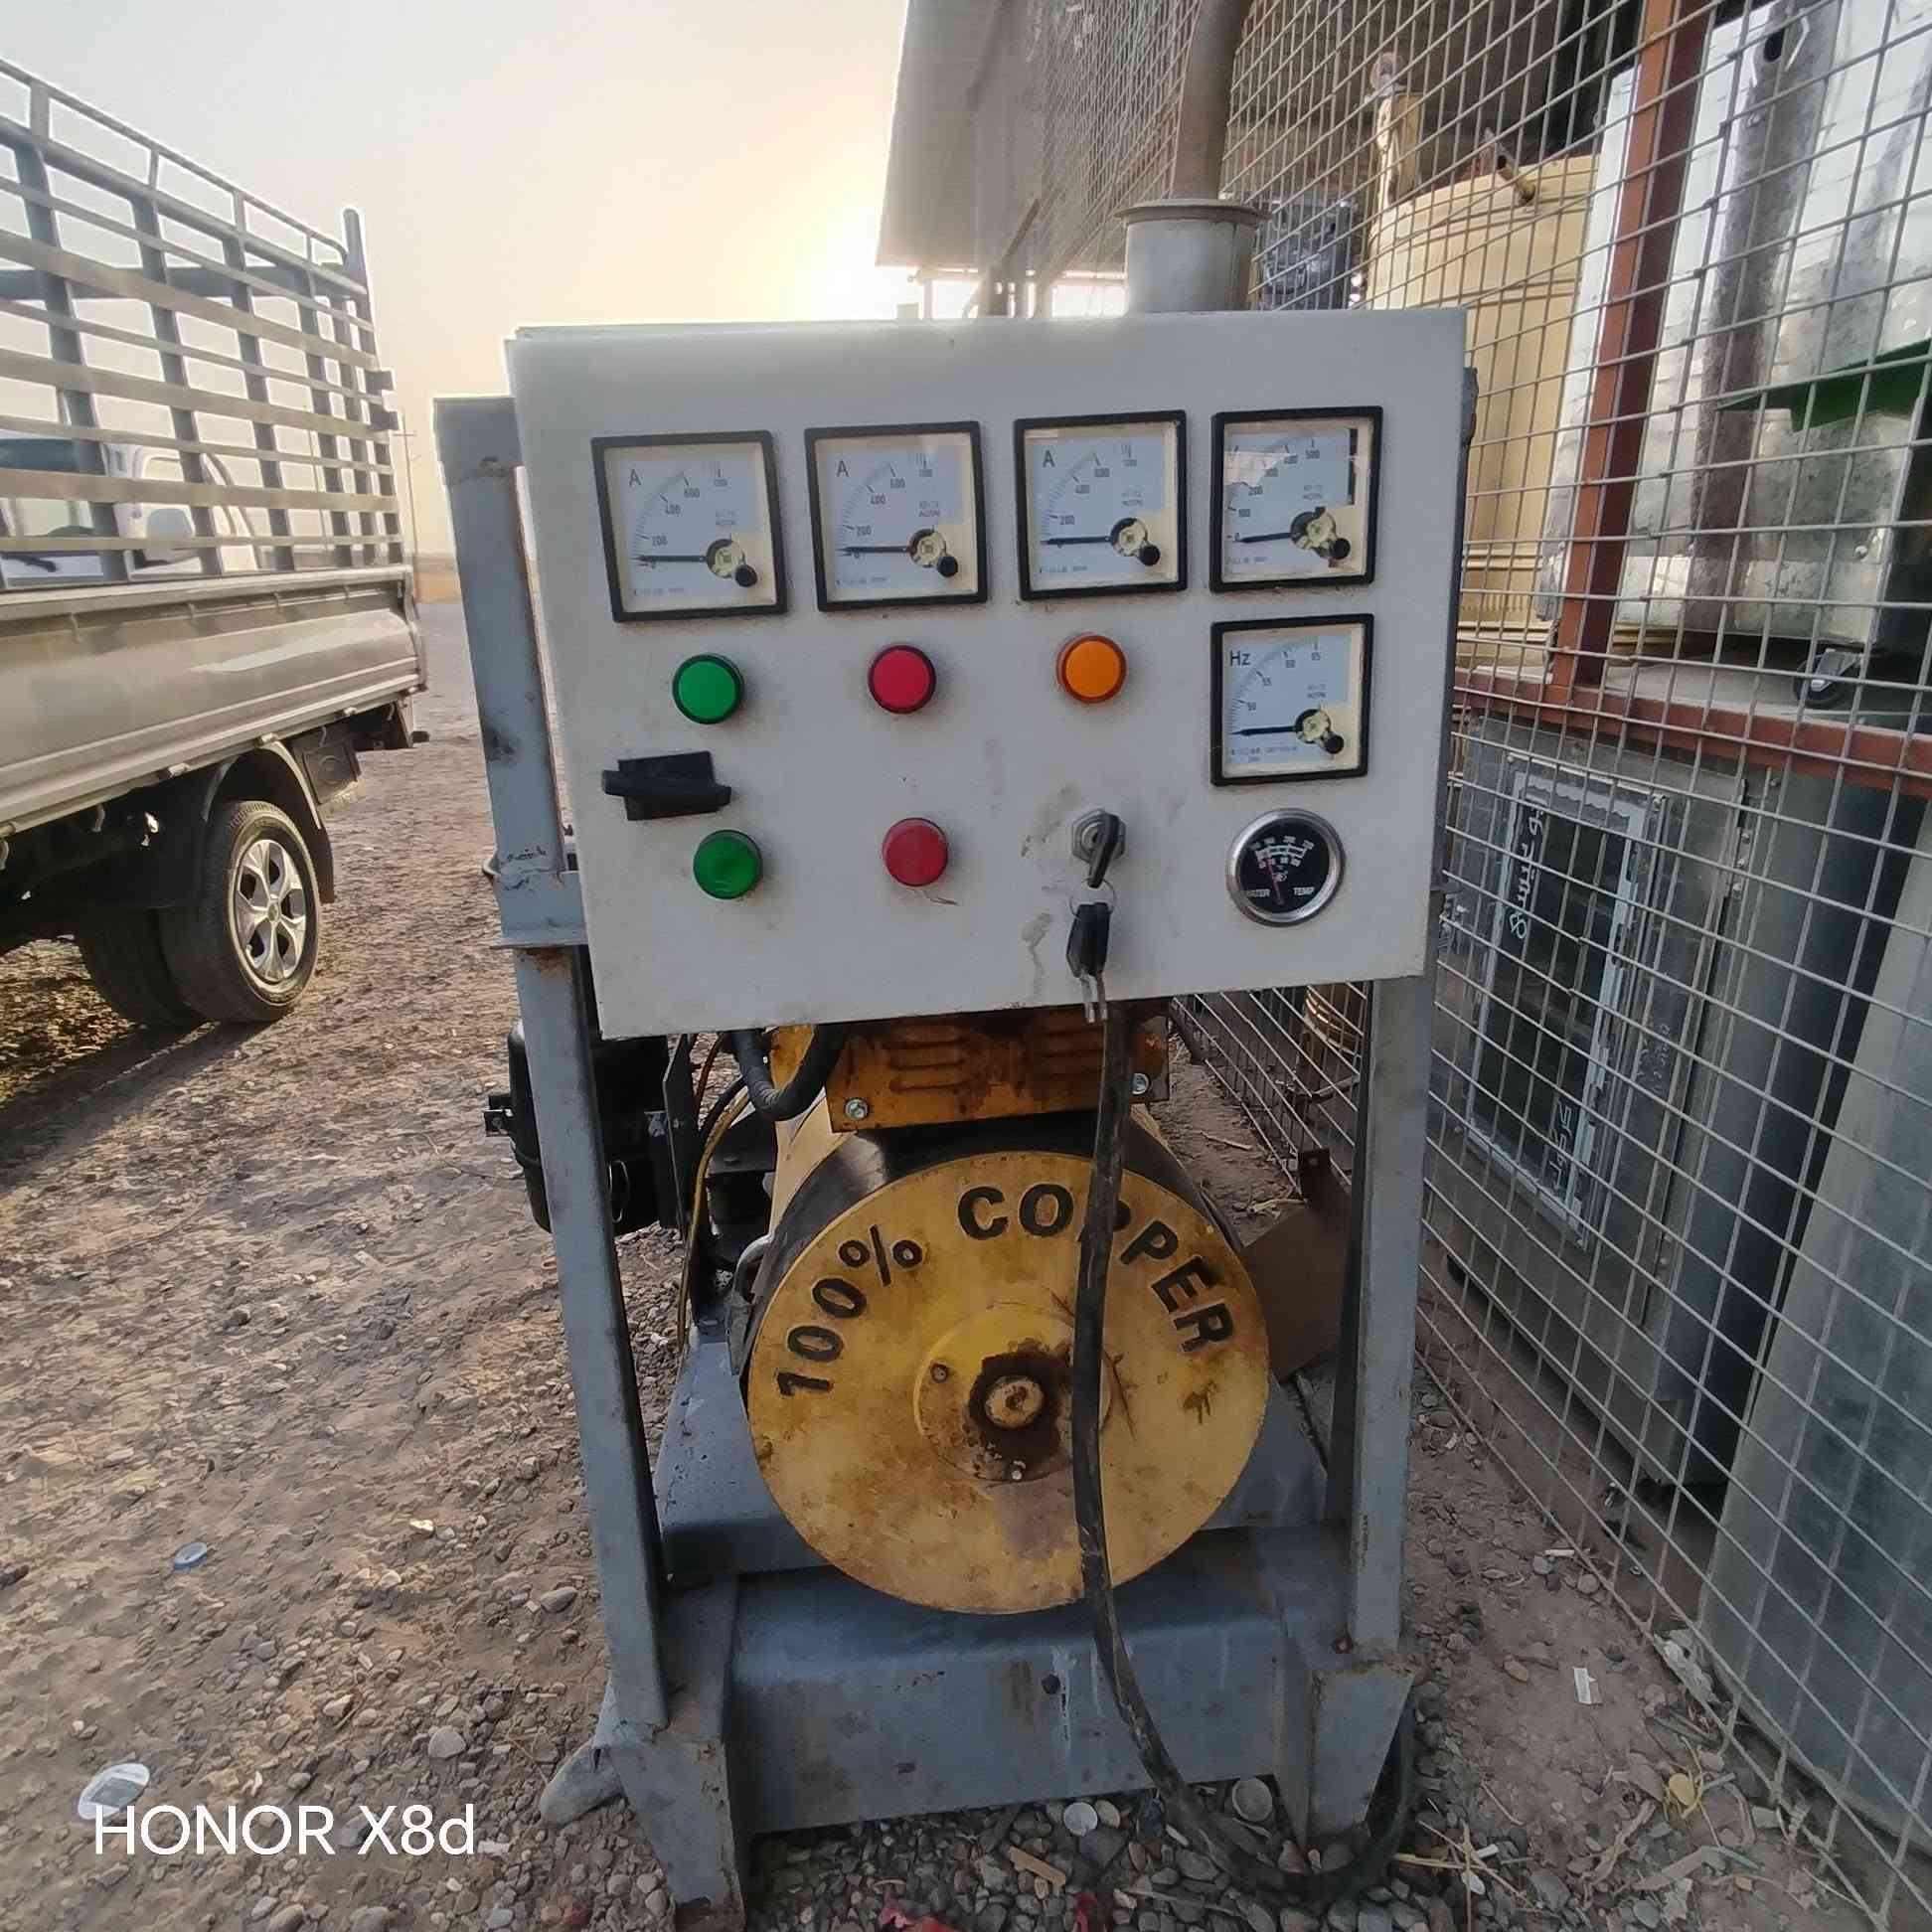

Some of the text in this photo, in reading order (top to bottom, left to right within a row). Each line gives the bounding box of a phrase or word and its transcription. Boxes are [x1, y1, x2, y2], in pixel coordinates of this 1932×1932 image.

[1043, 450, 1055, 467] A
[837, 460, 849, 477] A
[629, 469, 641, 487] A
[1229, 650, 1250, 666] Hz
[775, 1224, 923, 1397] 100%
